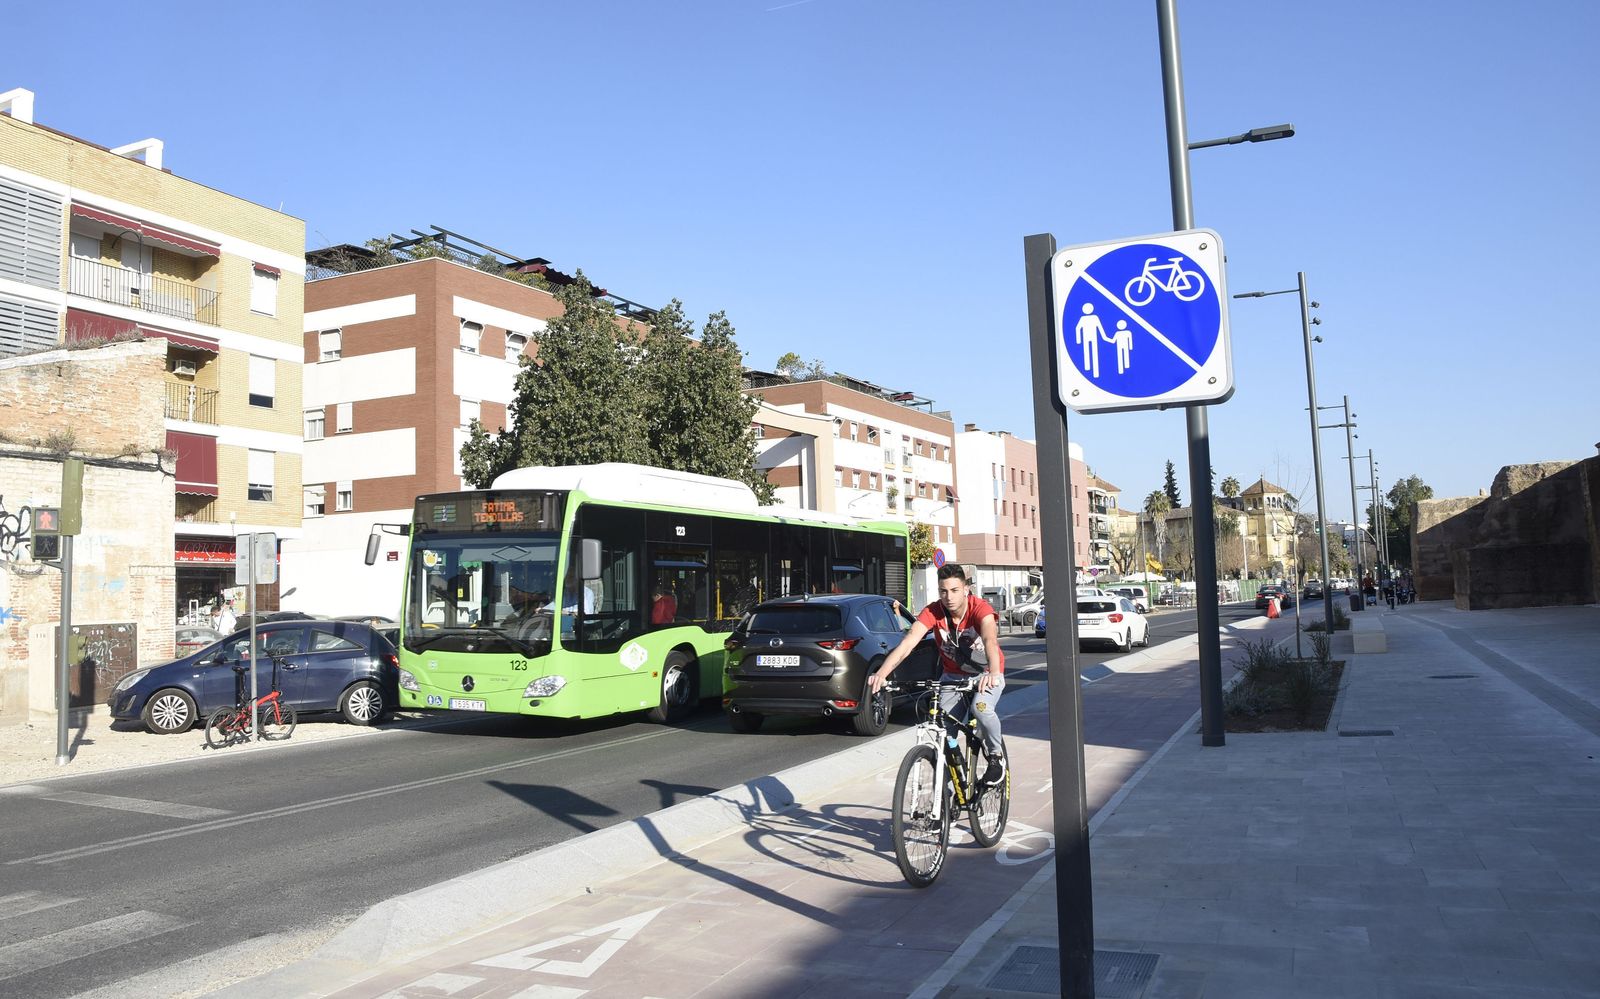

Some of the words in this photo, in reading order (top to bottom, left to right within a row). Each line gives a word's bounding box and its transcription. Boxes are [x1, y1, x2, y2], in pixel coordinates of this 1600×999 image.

[482, 501, 515, 512] FATIMA
[474, 512, 524, 522] TENDILLAS
[762, 655, 781, 665] 2883
[783, 655, 799, 665] KDG
[510, 660, 528, 671] 123
